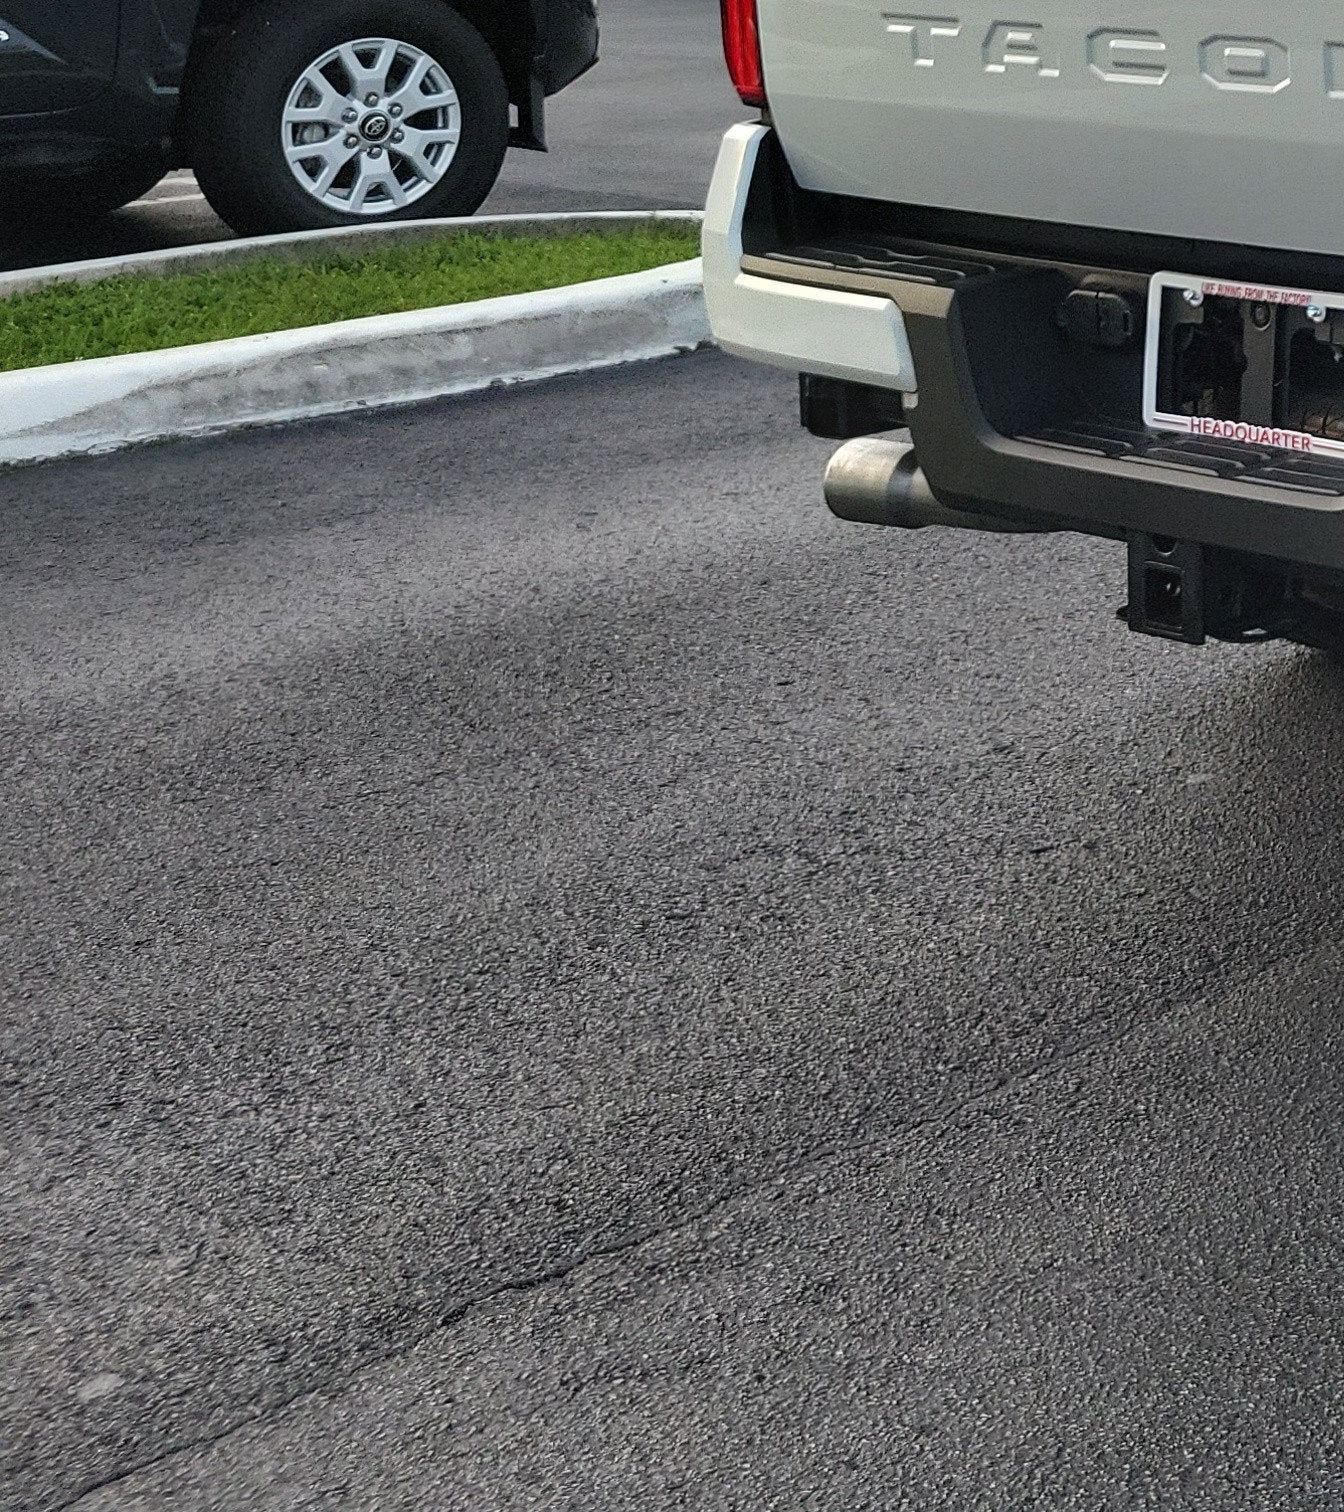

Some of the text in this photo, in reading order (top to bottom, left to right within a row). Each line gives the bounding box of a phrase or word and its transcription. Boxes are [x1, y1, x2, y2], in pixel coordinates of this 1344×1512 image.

[1244, 287, 1263, 301] FROM
[1267, 290, 1279, 301] THE
[1190, 416, 1312, 451] HEADQUARTER
